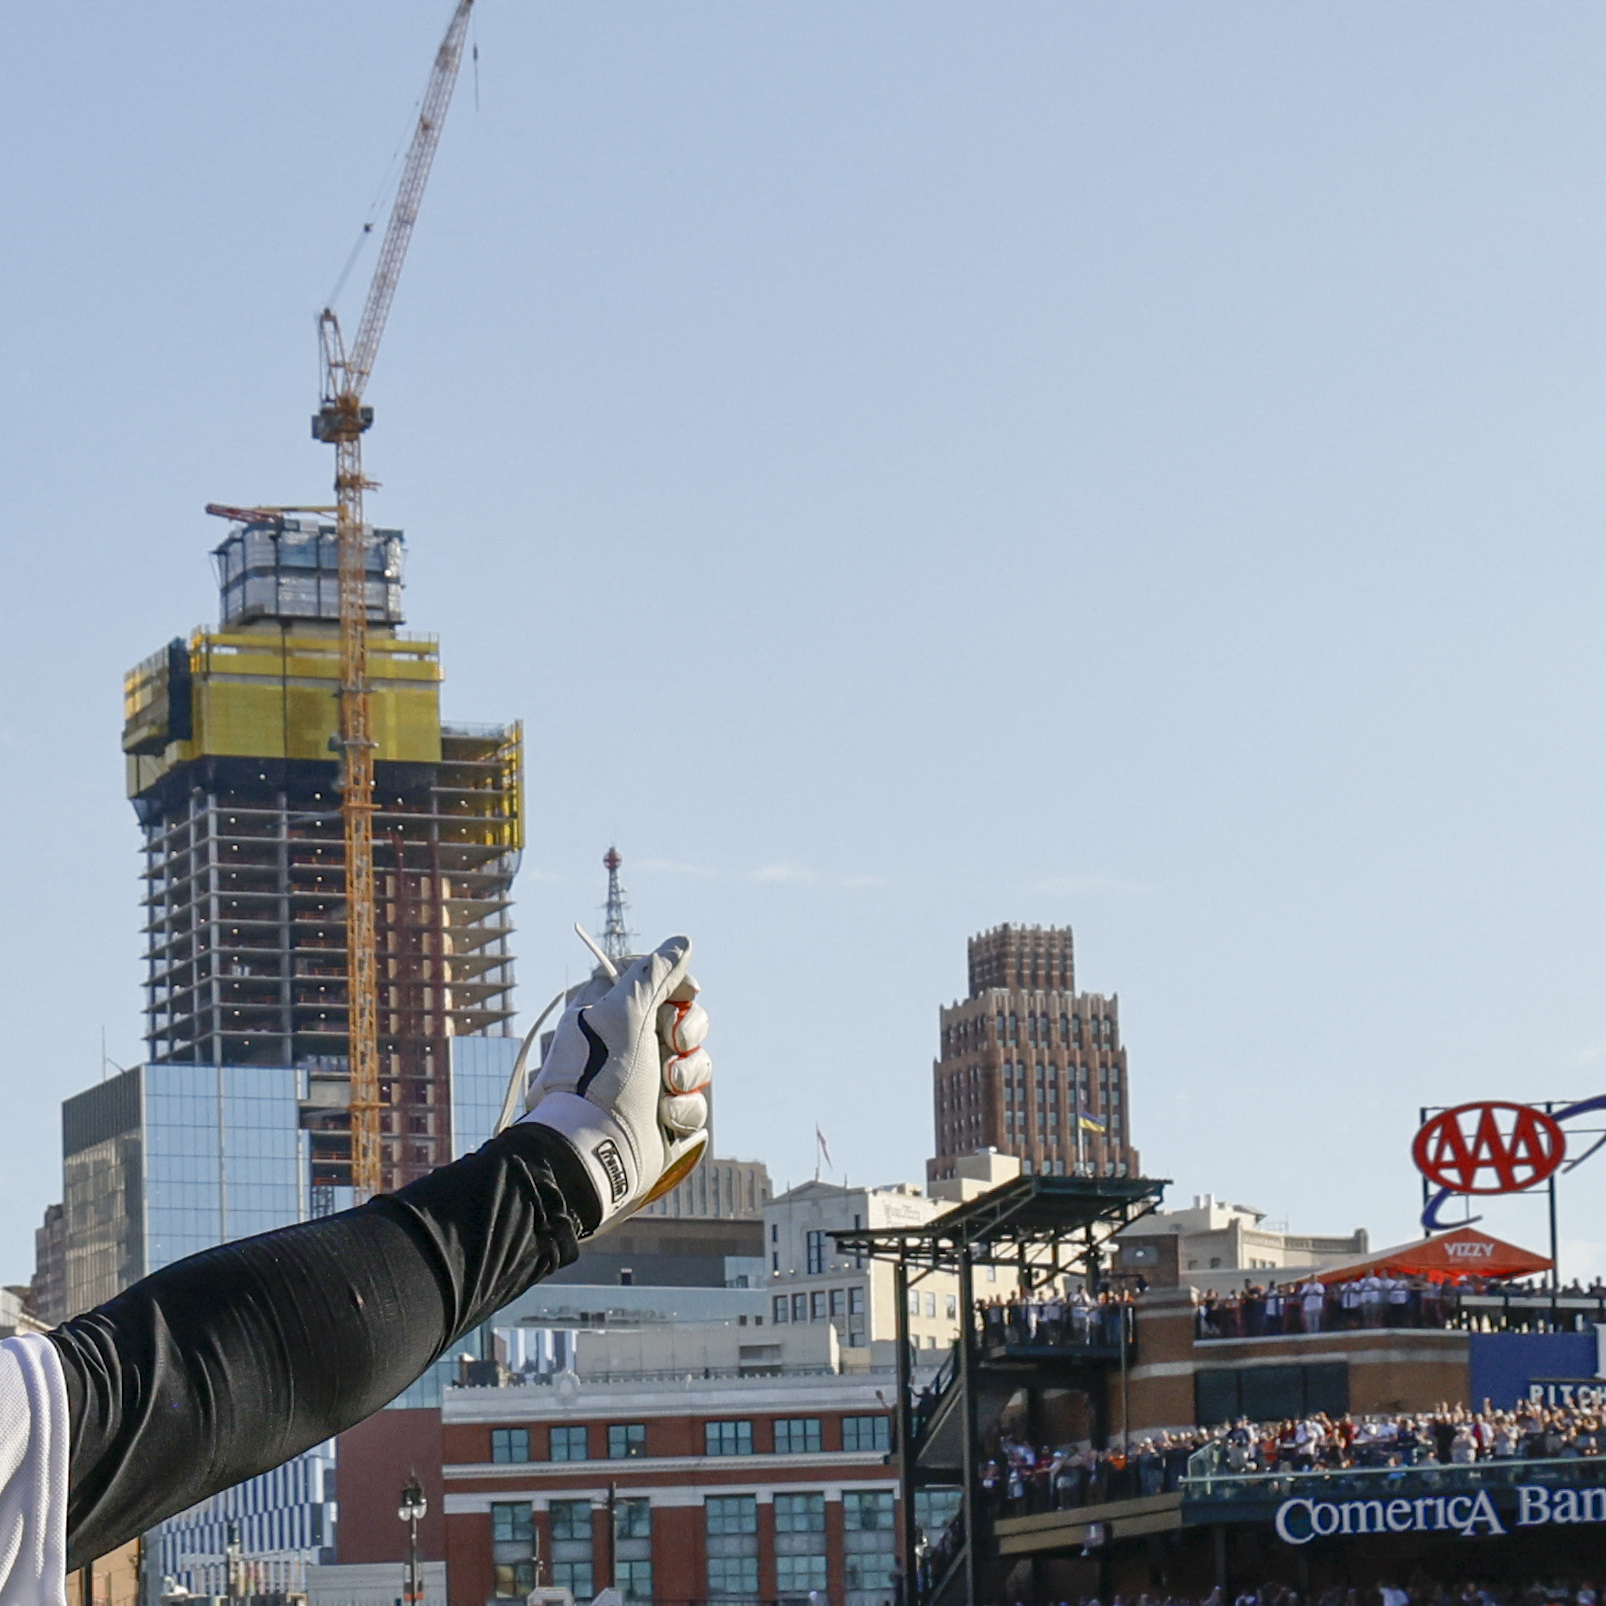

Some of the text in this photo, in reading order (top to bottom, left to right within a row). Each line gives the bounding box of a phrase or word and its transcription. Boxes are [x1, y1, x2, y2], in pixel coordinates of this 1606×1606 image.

[595, 1140, 627, 1202] Franklin
[1418, 1101, 1560, 1195] AAA
[1444, 1242, 1495, 1257] VIZZY
